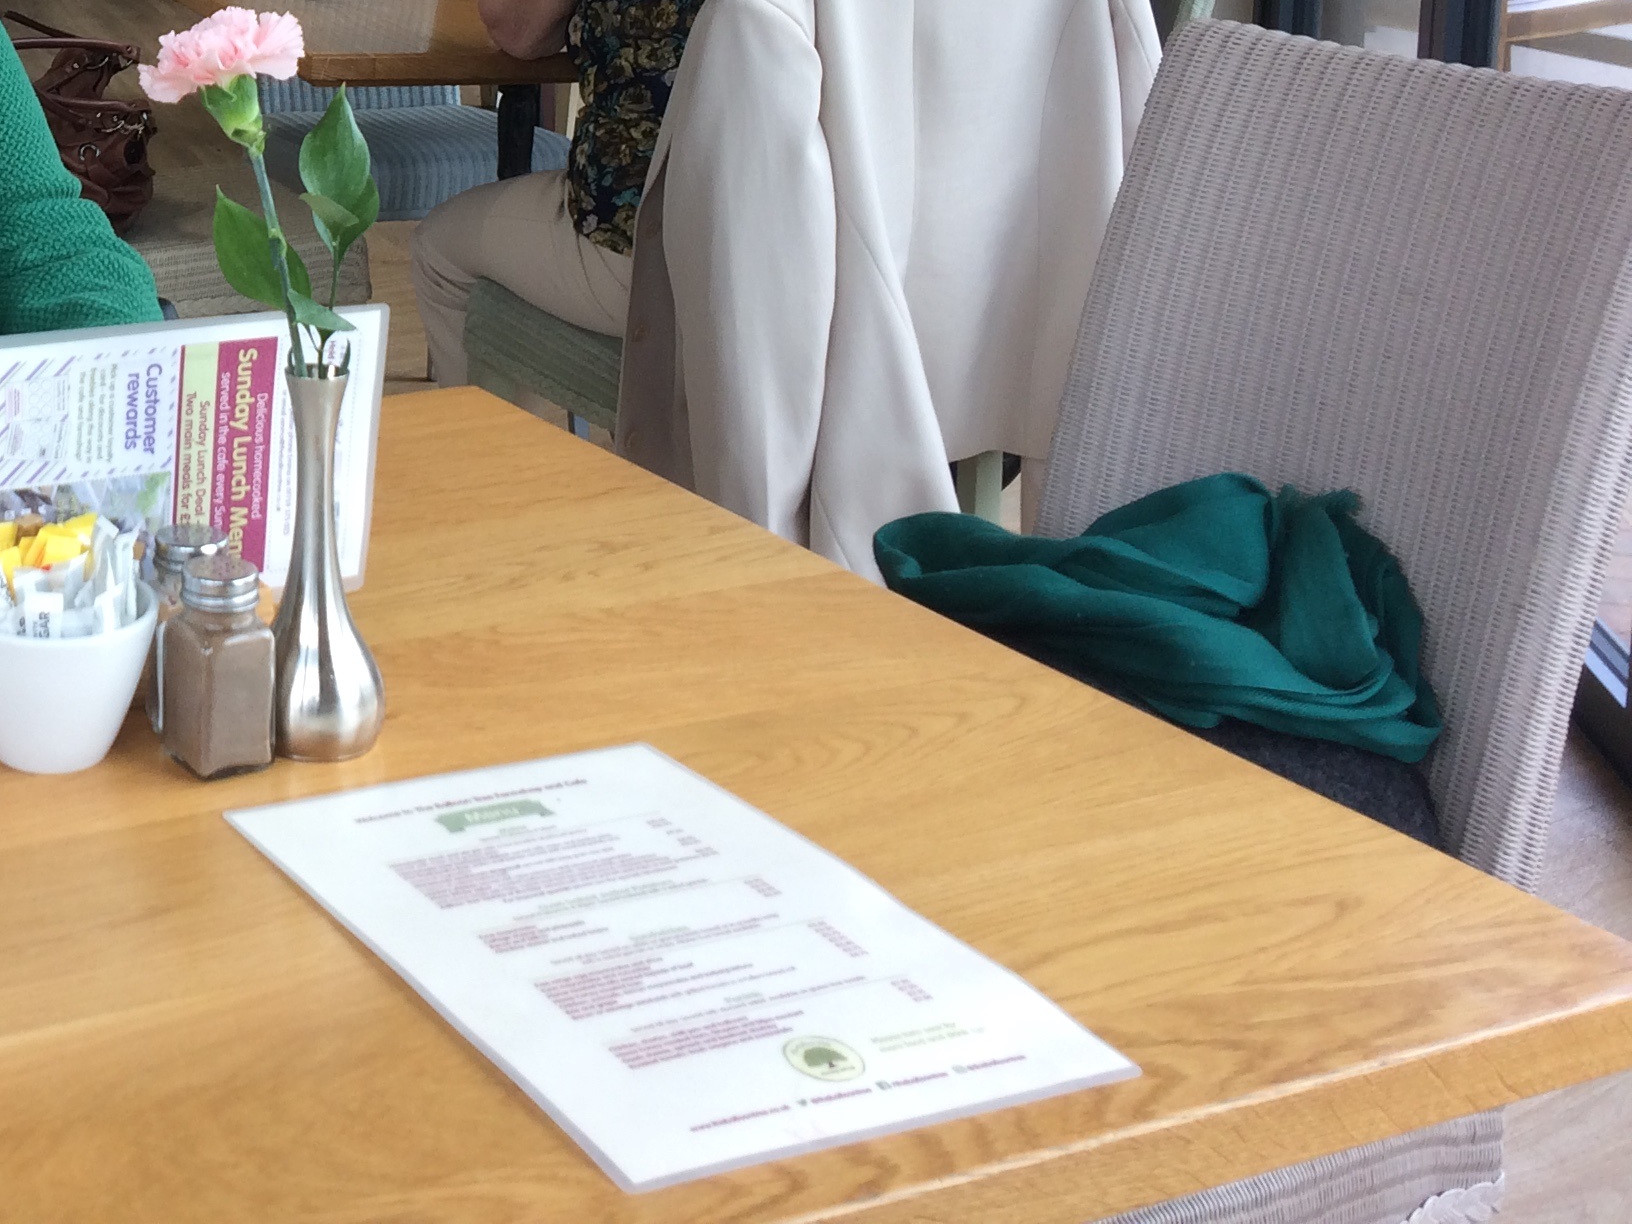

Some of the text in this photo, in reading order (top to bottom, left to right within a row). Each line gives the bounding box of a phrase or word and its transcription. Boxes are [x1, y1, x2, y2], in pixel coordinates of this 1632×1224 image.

[142, 363, 163, 454] Customer
[186, 392, 197, 415] Two
[229, 347, 258, 431] Sunday
[125, 373, 142, 449] rewards
[195, 400, 210, 446] Sunday
[183, 419, 195, 448] main
[213, 372, 231, 528] served in the cafe every Sun
[182, 453, 194, 490] meals
[196, 450, 208, 484] Lunch
[230, 436, 252, 501] Lunch
[251, 393, 268, 519] Delicious homecooked
[180, 493, 192, 509] for
[195, 488, 206, 516] Deal
[39, 611, 51, 638] GAR
